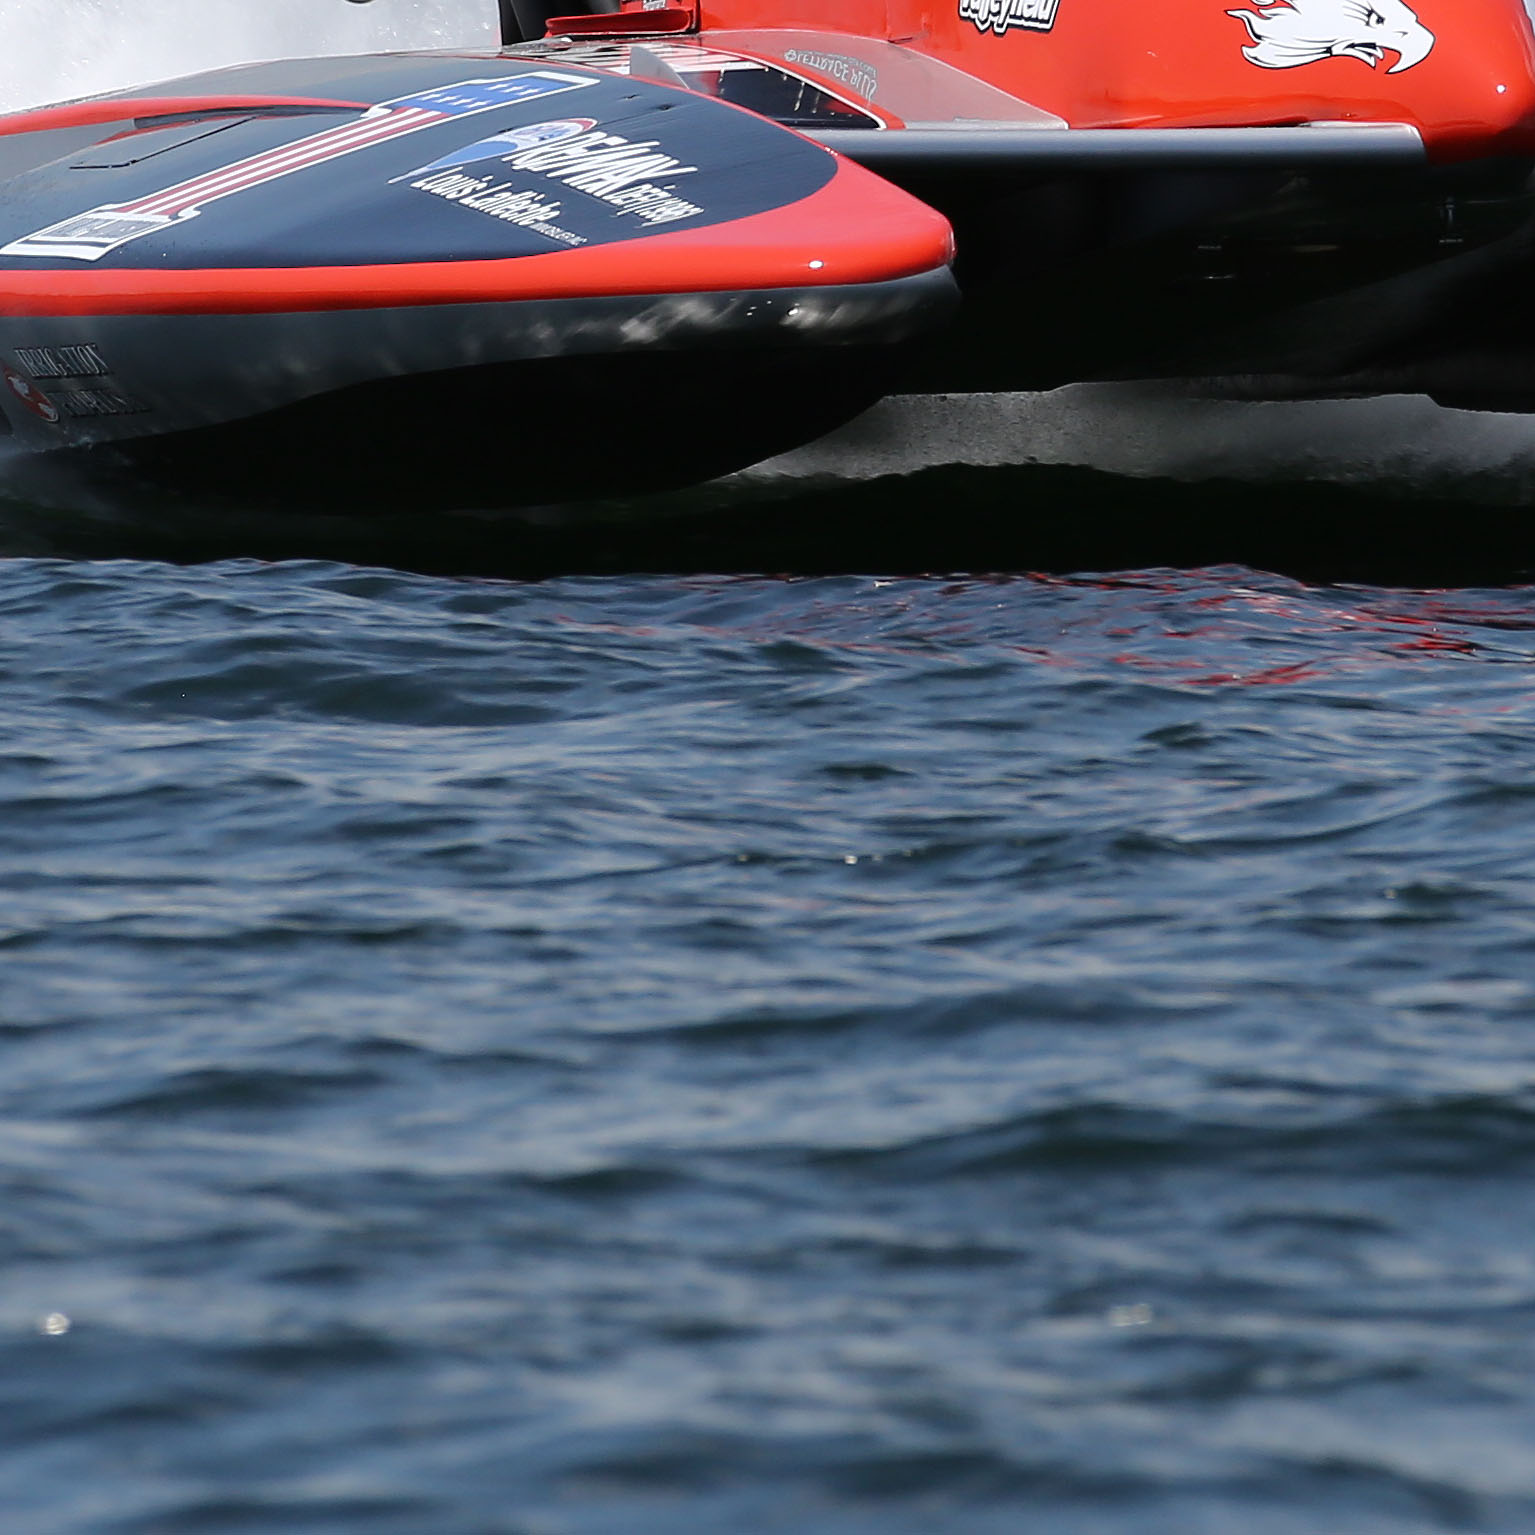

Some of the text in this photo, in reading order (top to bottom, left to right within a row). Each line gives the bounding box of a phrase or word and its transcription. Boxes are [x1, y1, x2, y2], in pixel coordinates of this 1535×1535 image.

[501, 131, 699, 198] RE/MAX
[409, 166, 562, 227] Louis Laflèche
[14, 343, 112, 378] IRRIGATION
